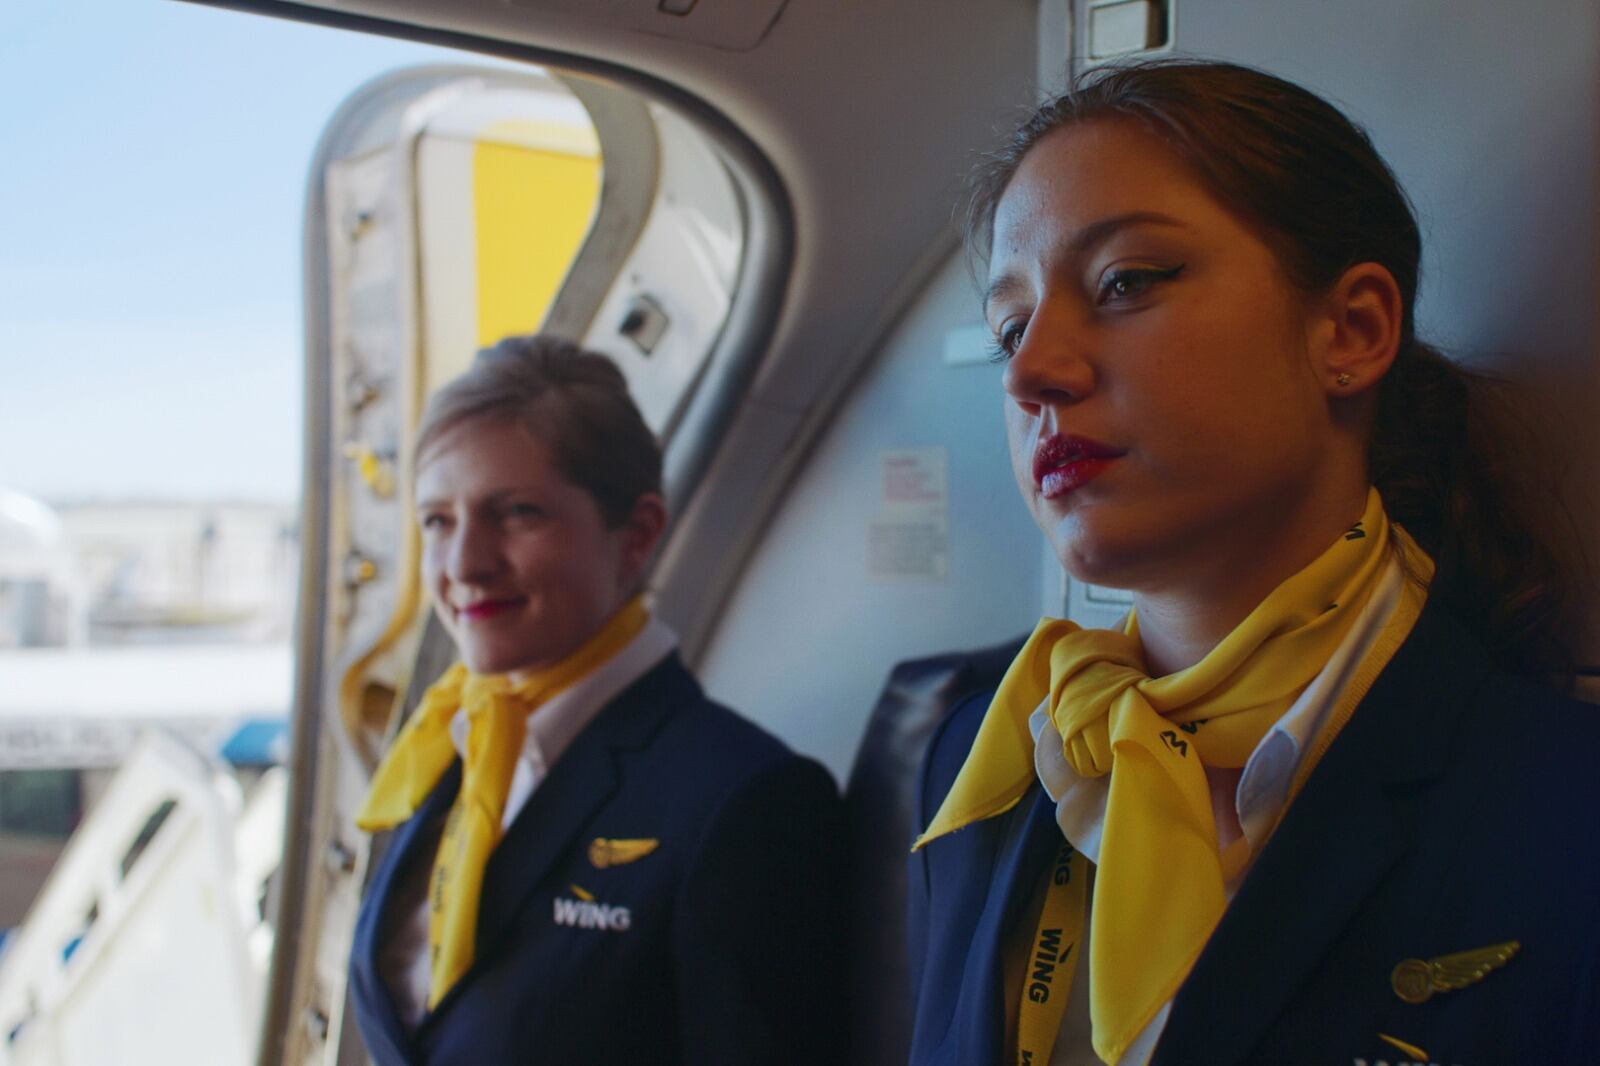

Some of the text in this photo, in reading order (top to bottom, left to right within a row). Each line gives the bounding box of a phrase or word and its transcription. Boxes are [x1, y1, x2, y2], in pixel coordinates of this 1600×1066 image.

[1054, 844, 1074, 886] NG
[553, 897, 631, 931] WING
[1028, 928, 1064, 1005] WING
